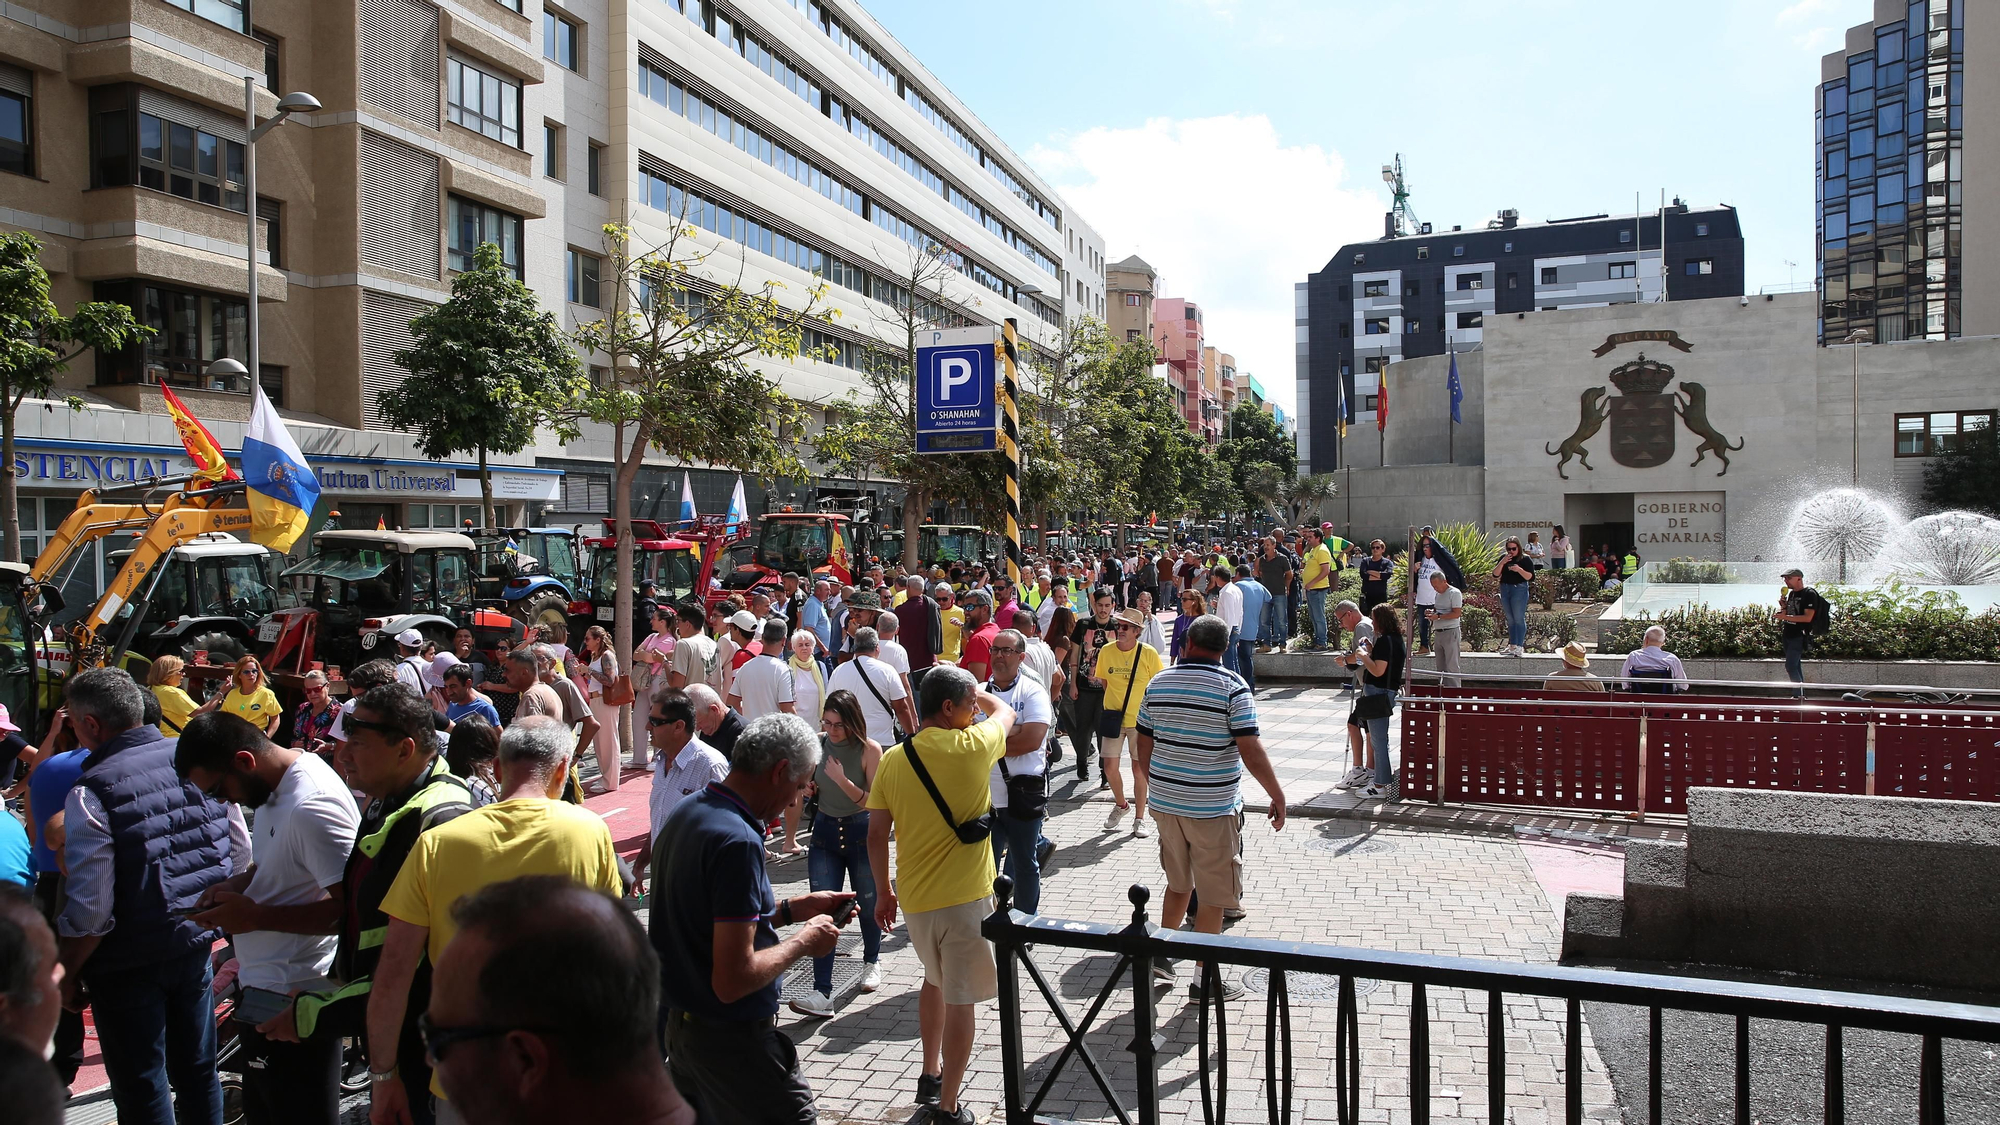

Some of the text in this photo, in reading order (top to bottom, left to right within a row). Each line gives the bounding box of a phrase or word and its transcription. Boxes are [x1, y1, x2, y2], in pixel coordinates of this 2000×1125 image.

[940, 357, 972, 401] P
[14, 451, 170, 482] STENCIAL
[374, 469, 456, 491] Universal
[1637, 502, 1722, 514] GOBIERNO
[1493, 521, 1554, 529] PRESIDENCIA
[1668, 517, 1689, 528] DE
[1637, 532, 1723, 543] CANARIAS
[363, 633, 376, 648] 40
